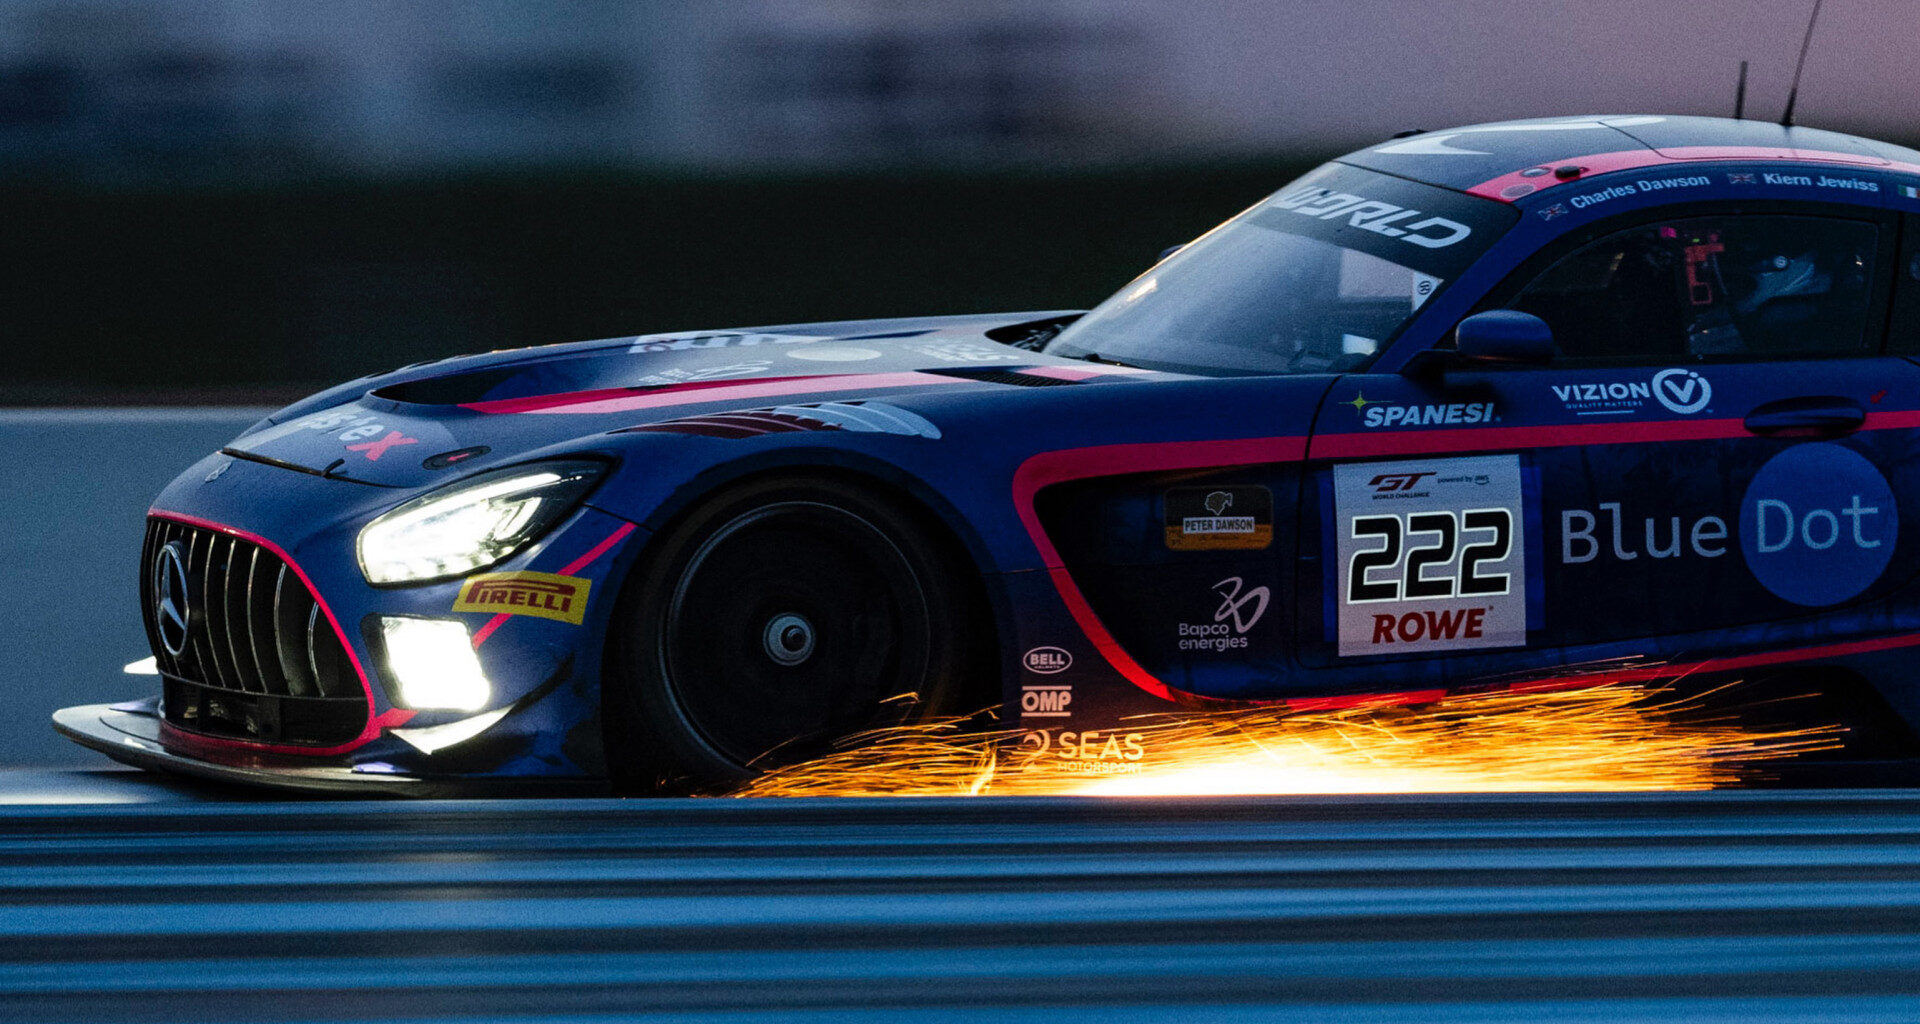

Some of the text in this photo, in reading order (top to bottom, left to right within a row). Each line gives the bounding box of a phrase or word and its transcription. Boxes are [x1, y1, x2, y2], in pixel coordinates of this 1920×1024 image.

[1570, 176, 1711, 208] Charles Dawson
[1763, 172, 1879, 192] Kiern Jewiss
[1552, 382, 1650, 401] VIZION
[1363, 403, 1495, 428] SPANESI
[1368, 471, 1438, 492] GT
[1437, 475, 1464, 484] powered
[1465, 475, 1473, 483] by
[1185, 518, 1253, 531] PETER DAWSON
[1562, 495, 1881, 563] Blue Dot
[1347, 507, 1514, 605] 222
[465, 578, 576, 613] PIRELLI
[1179, 623, 1230, 638] Bapco
[1372, 608, 1486, 645] ROWE
[1178, 635, 1249, 652] energies
[1030, 653, 1065, 665] BELL
[1021, 691, 1072, 711] OMP
[1058, 731, 1145, 760] SEAS
